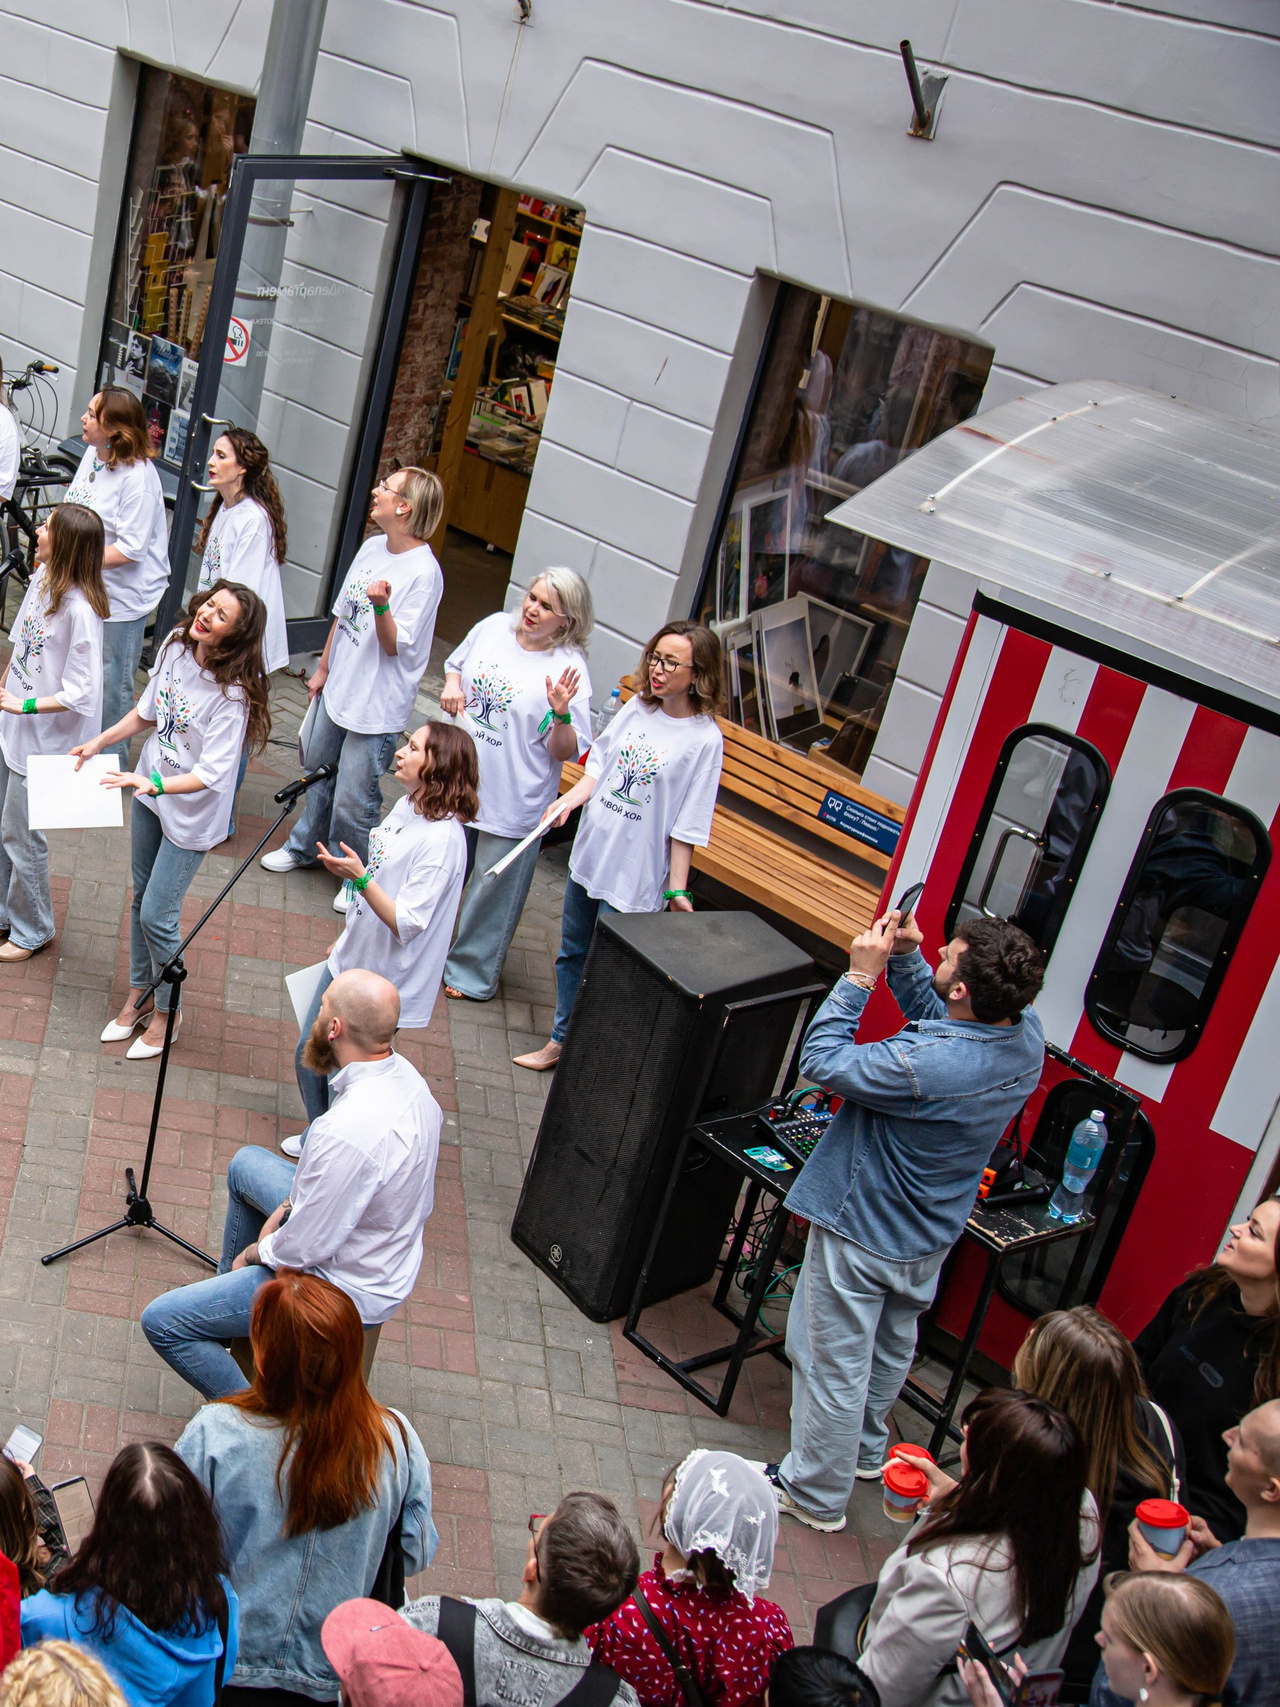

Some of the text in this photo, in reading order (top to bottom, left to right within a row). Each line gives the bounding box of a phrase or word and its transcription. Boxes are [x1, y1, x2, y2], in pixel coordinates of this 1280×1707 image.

[485, 735, 502, 747] ХОР
[163, 755, 180, 769] ХОР
[623, 810, 642, 821] ХОР
